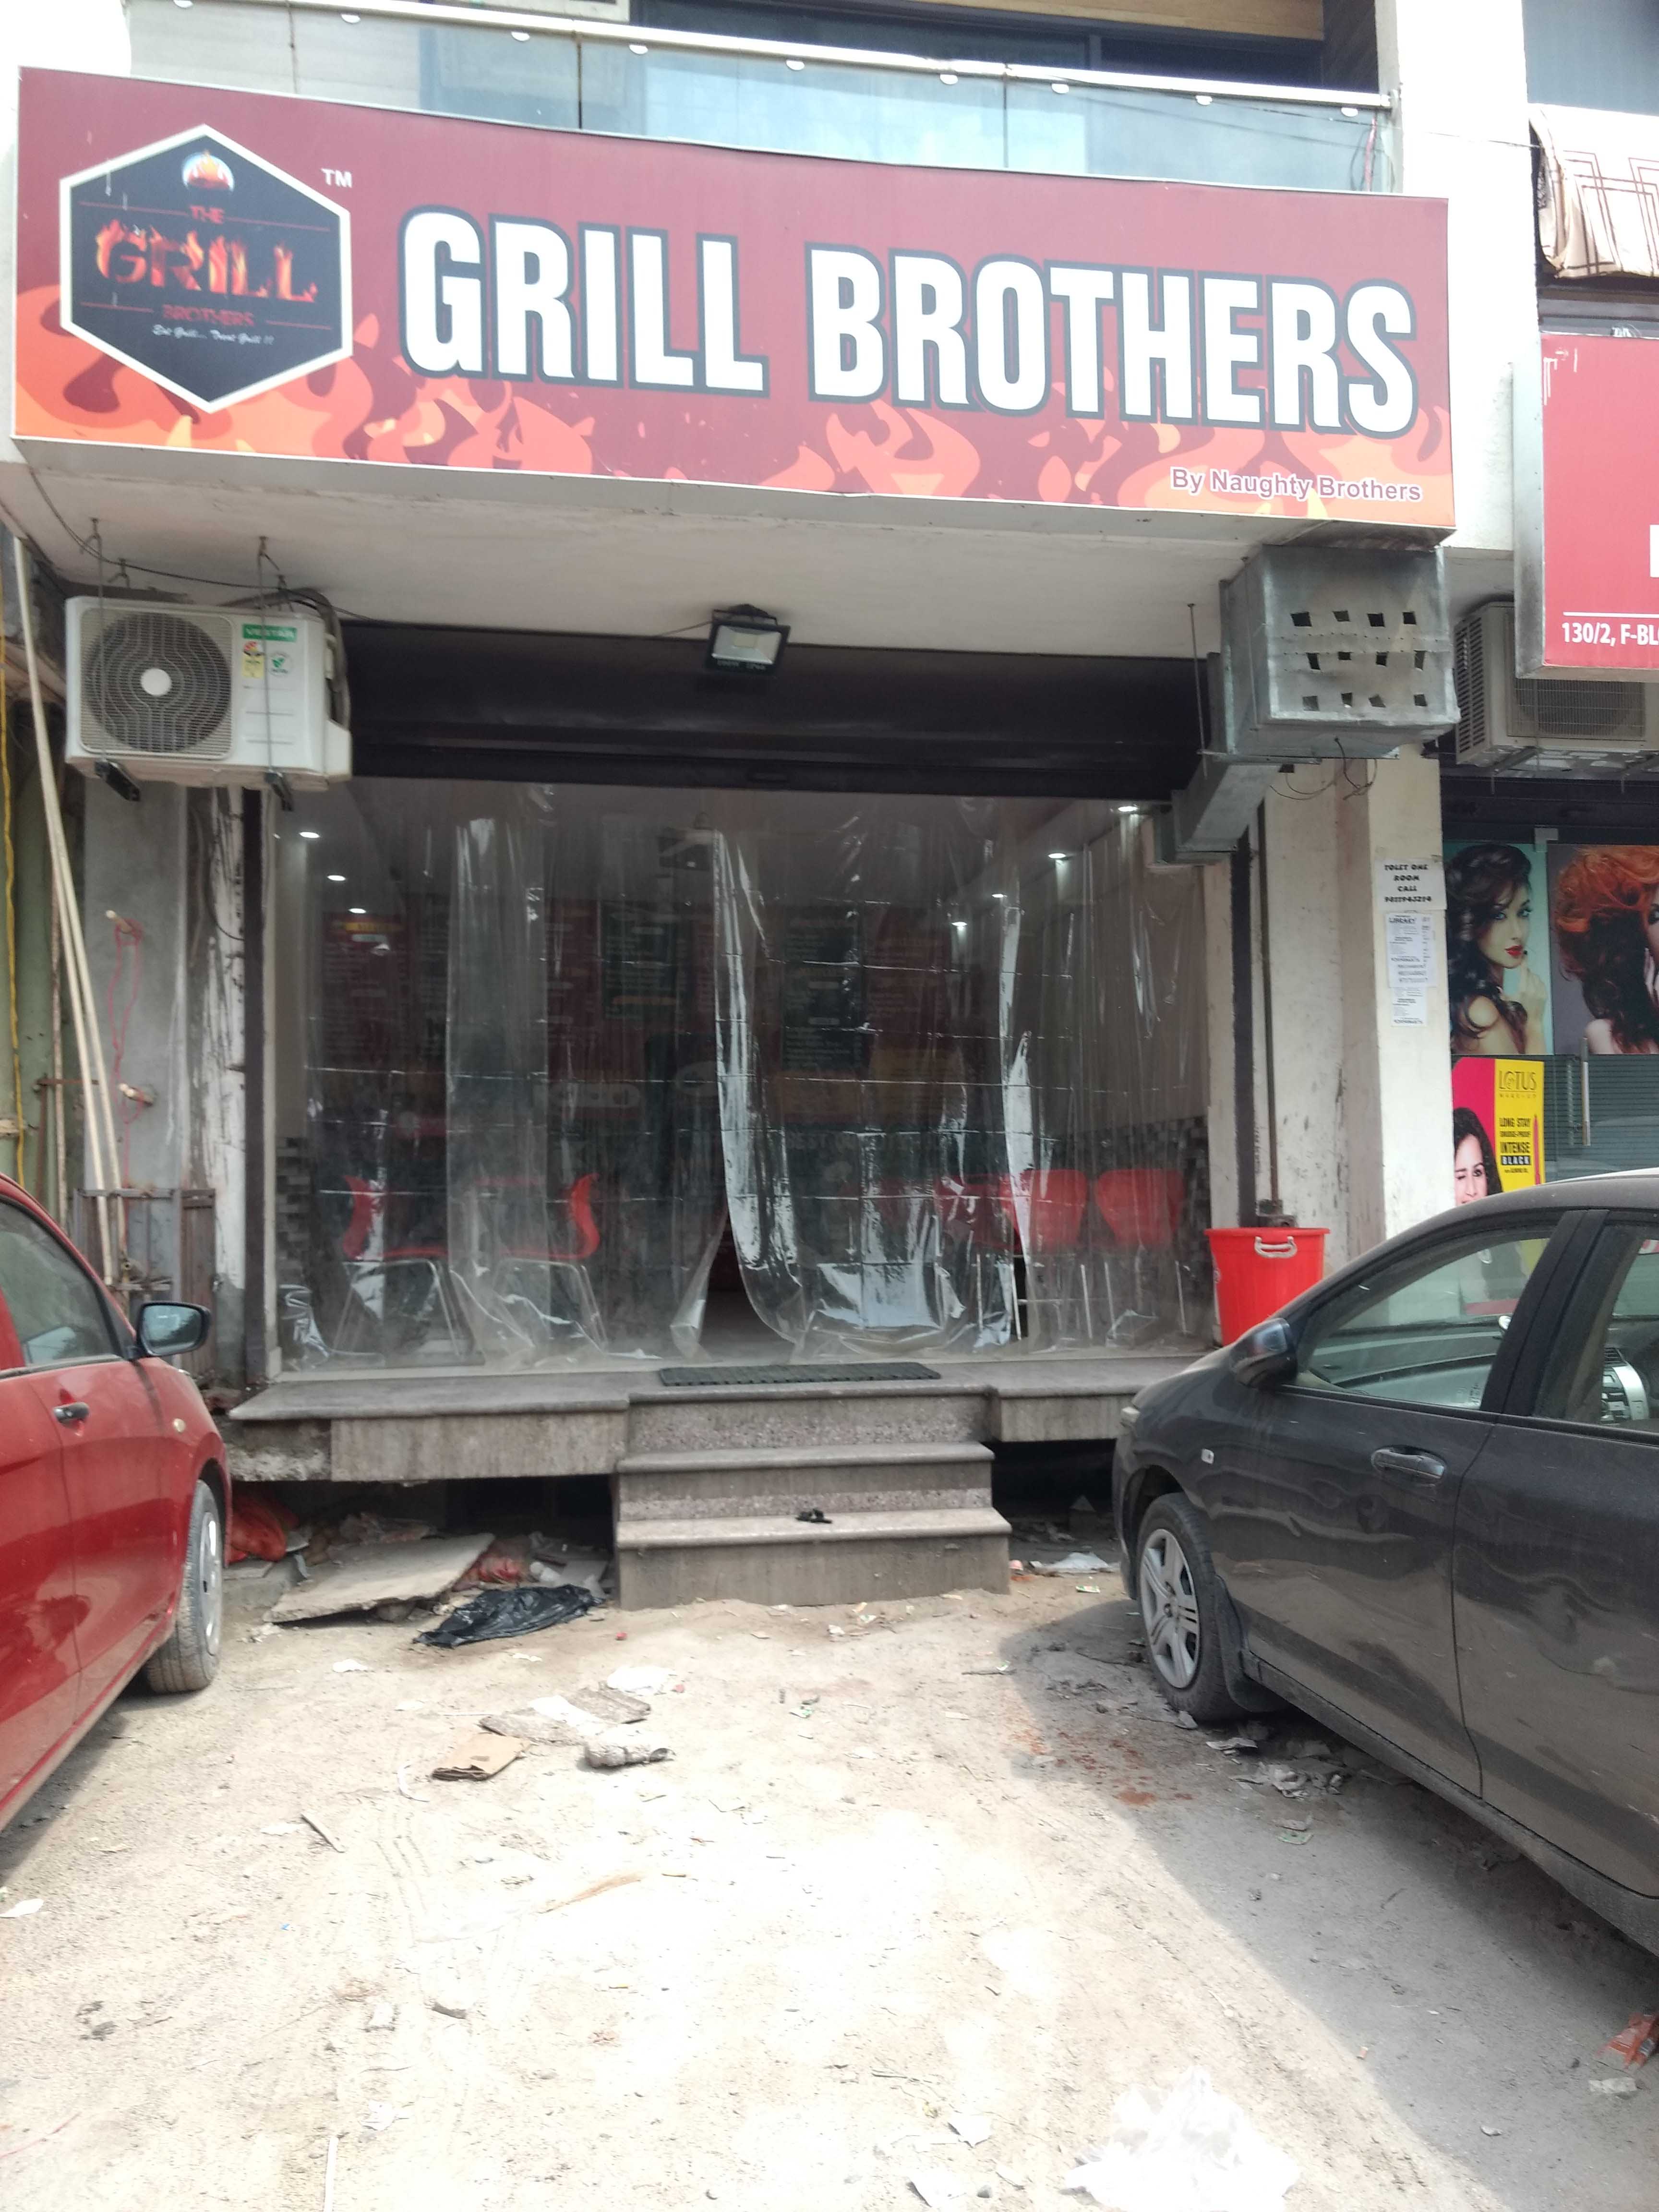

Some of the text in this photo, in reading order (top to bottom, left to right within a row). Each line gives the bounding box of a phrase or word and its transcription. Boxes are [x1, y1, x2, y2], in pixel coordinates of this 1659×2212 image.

[321, 168, 352, 188] TM
[190, 204, 225, 224] THE
[96, 218, 318, 303] GRILL
[400, 205, 1418, 439] GRILL BROTHERS
[1172, 468, 1422, 502] By Naughty Brothers
[1562, 622, 1659, 647] 130/2, F-BL
[1499, 1070, 1537, 1090] LOTUS
[1499, 1118, 1515, 1127] LONG
[1500, 1142, 1530, 1154] INTENSE
[1502, 1155, 1530, 1165] BLACK
